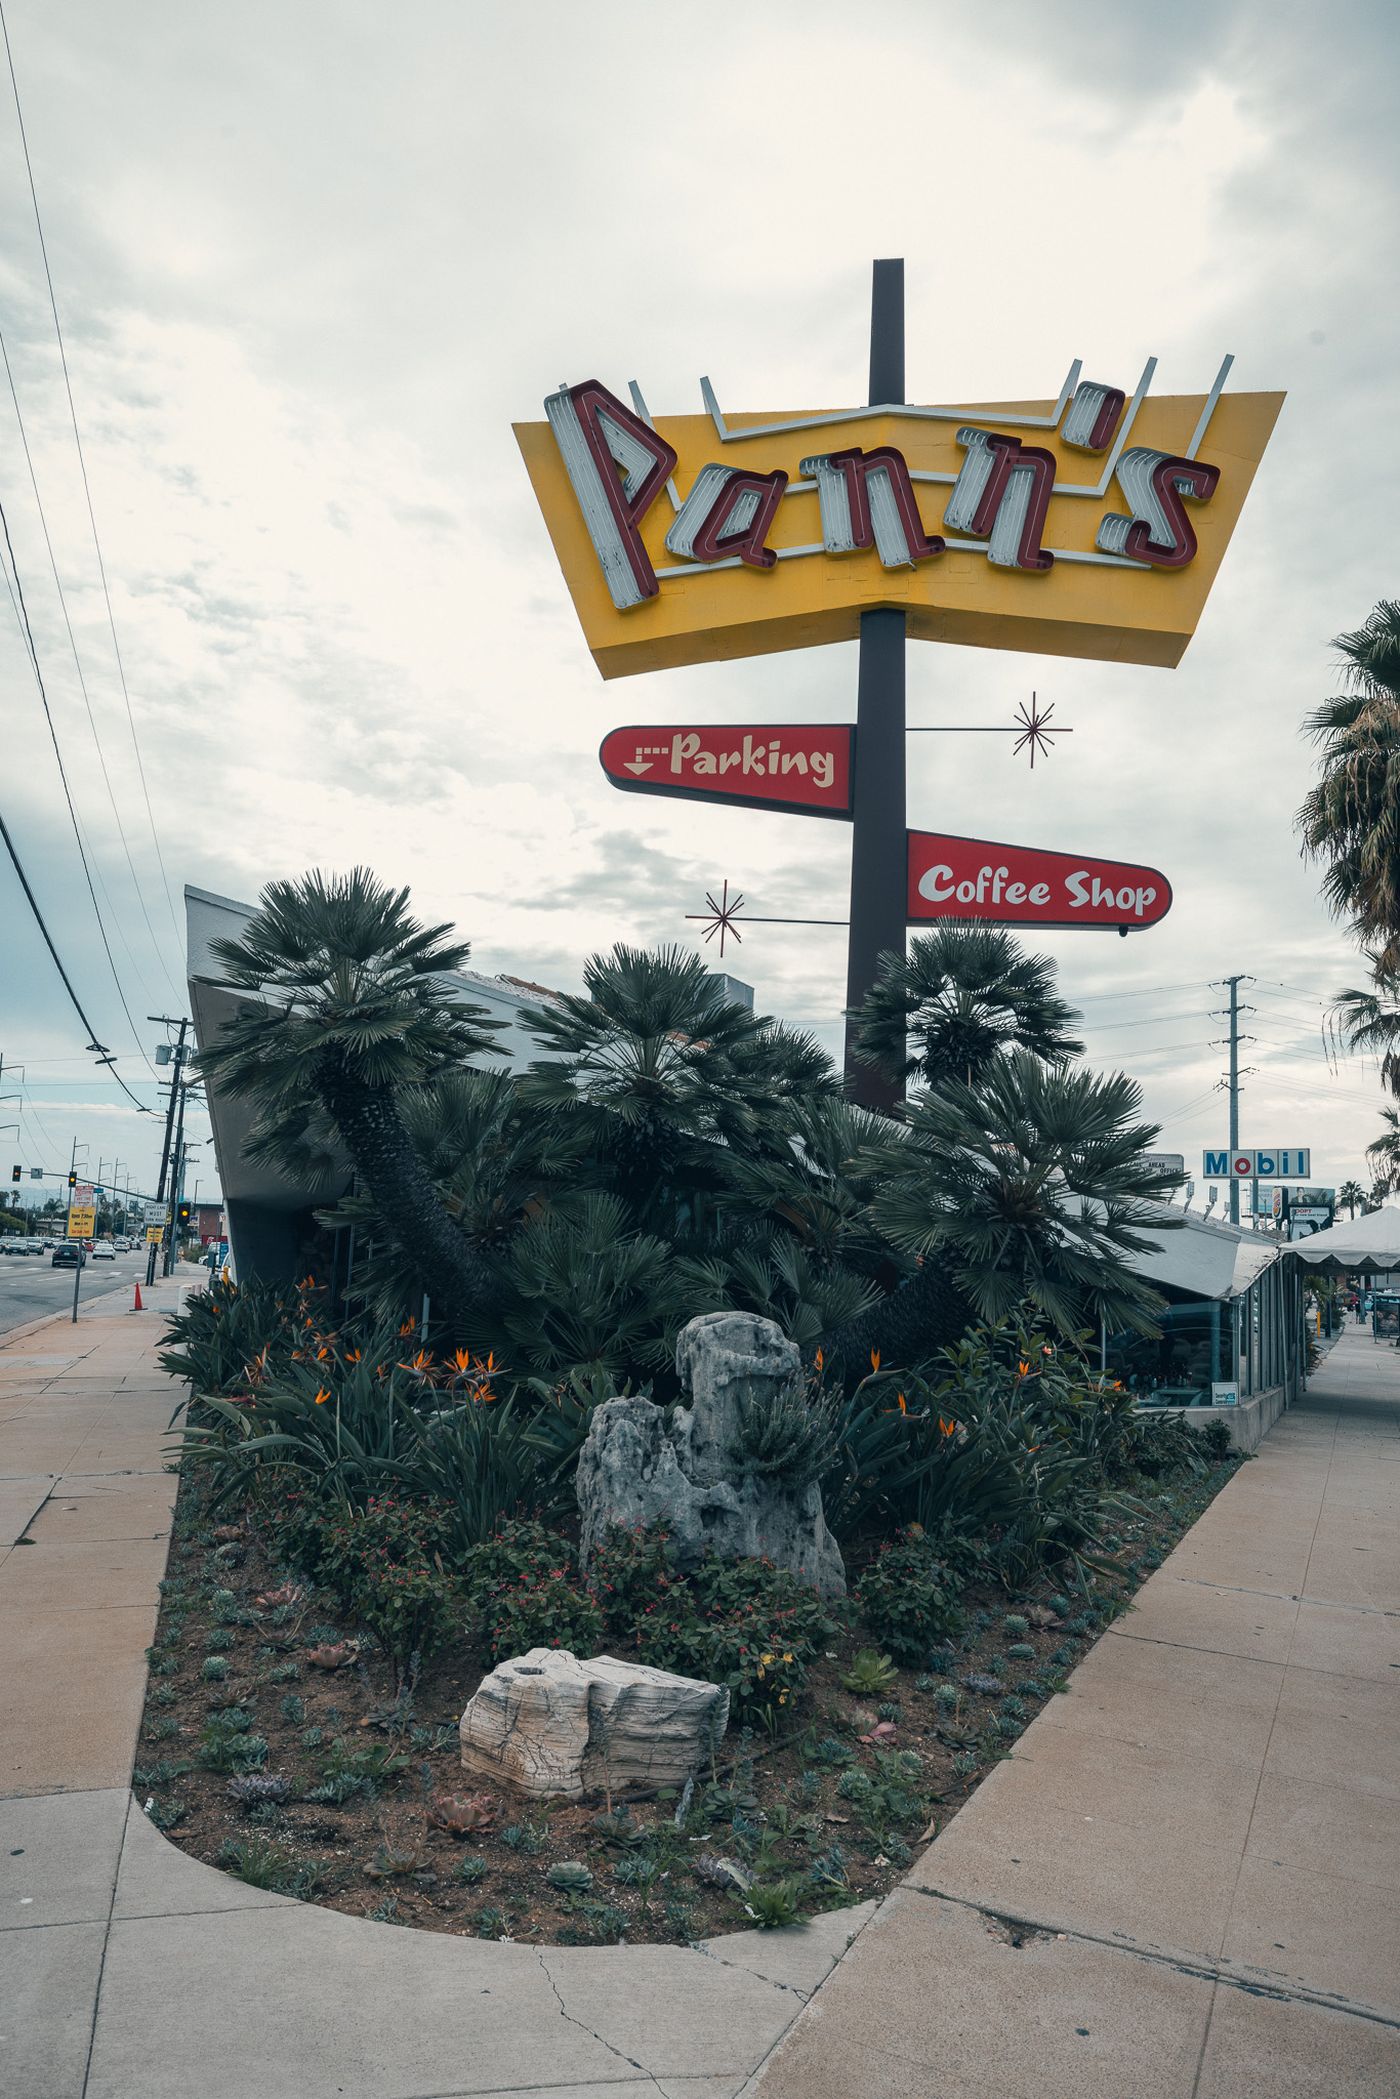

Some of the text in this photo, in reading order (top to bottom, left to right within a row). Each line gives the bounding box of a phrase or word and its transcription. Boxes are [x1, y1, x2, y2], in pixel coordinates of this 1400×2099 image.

[544, 378, 1220, 611] Pann's
[670, 733, 834, 788] Parking
[918, 864, 1157, 916] Coffee Shop
[1206, 1151, 1304, 1174] Mobil
